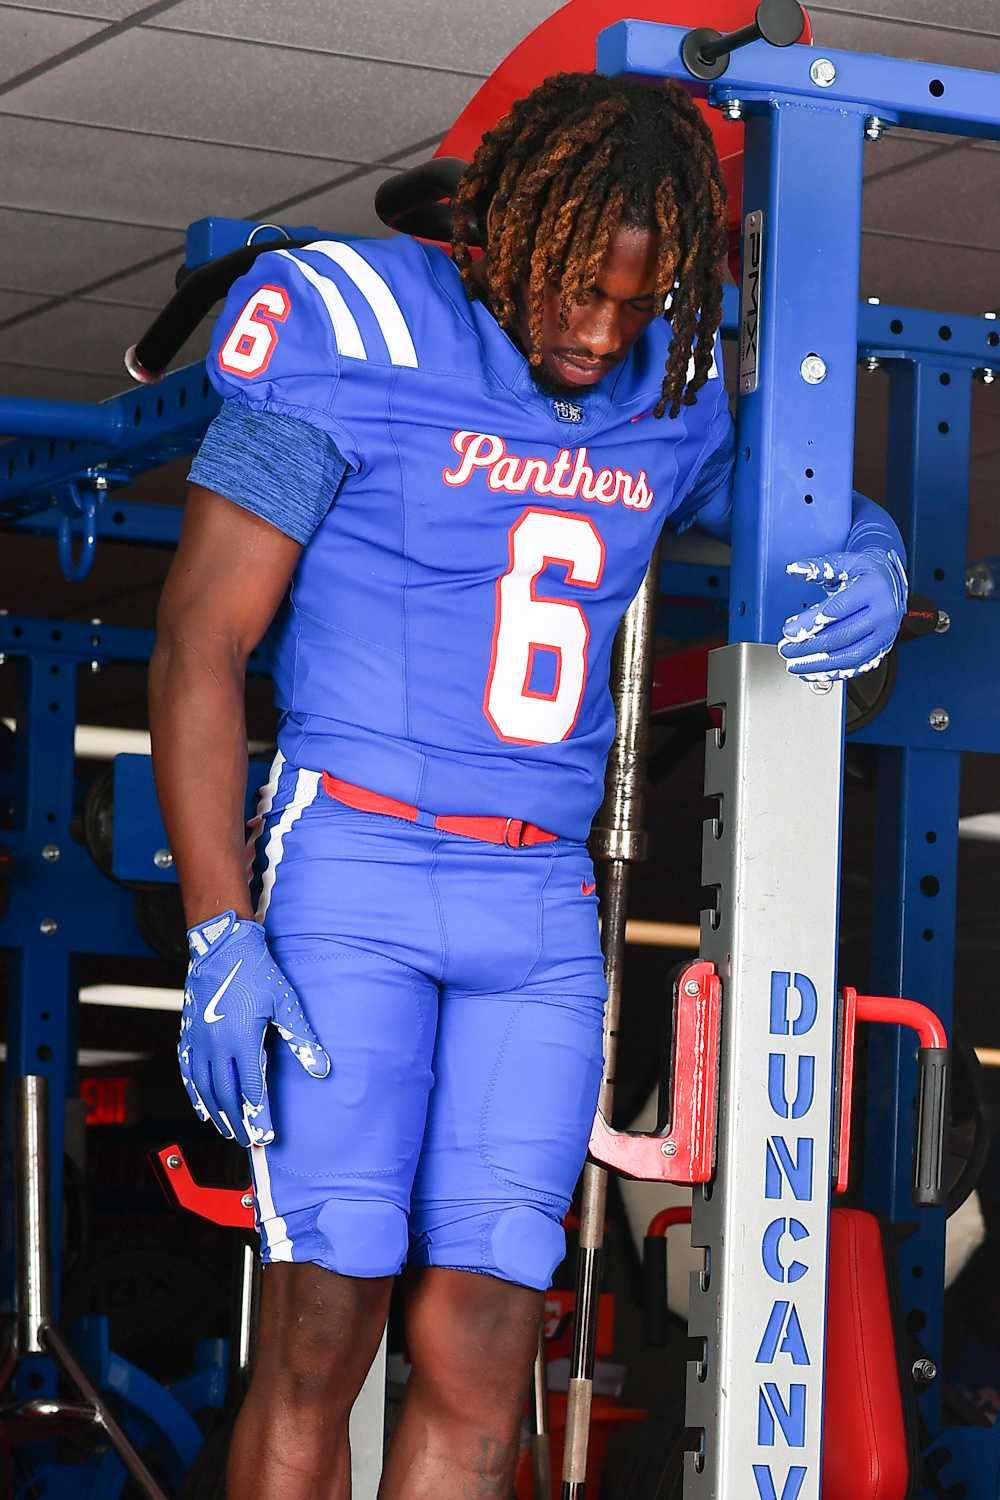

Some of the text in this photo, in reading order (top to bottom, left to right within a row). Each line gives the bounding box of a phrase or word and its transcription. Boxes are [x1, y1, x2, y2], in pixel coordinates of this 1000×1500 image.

[218, 284, 291, 379] 6
[746, 233, 760, 362] PMX
[442, 429, 654, 512] Panthers
[483, 507, 606, 746] 6
